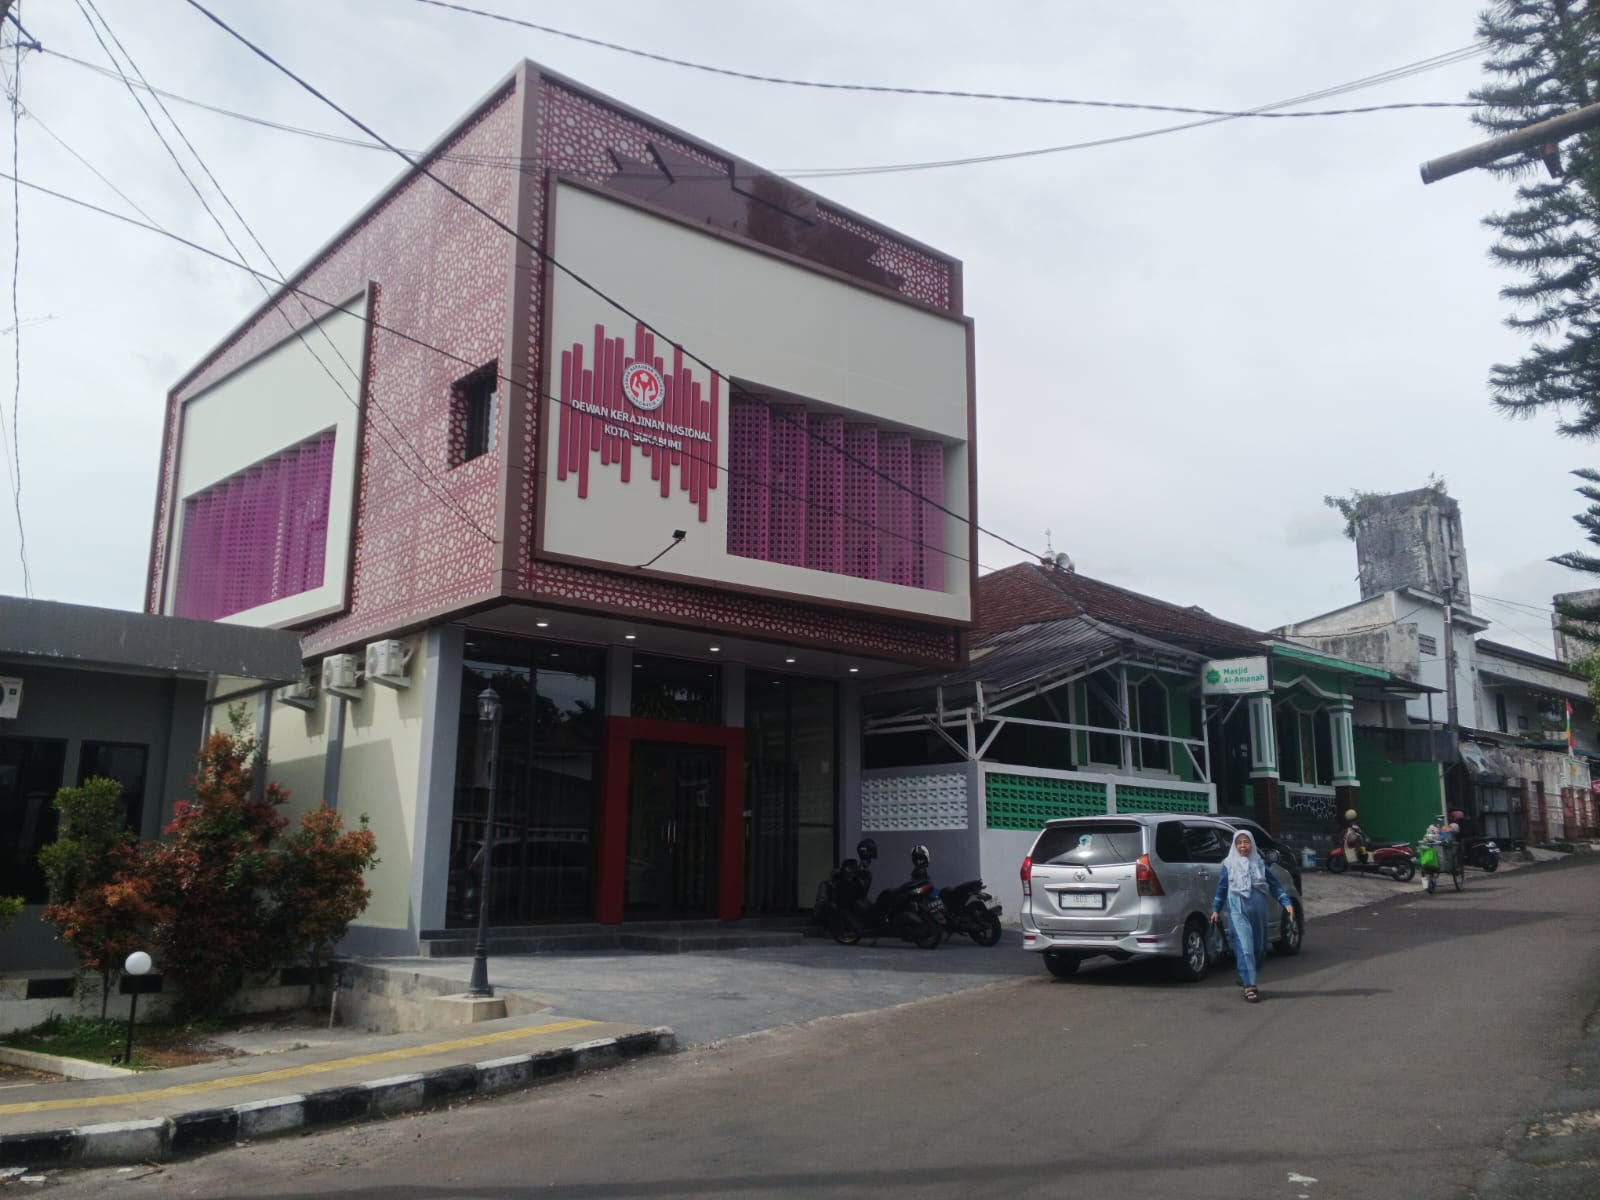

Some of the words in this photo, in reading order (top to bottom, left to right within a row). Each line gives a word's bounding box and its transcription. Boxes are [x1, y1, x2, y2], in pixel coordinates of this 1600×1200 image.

[572, 399, 609, 416] DEWAN
[610, 409, 665, 431] KERAJINAN
[666, 423, 712, 442] NASIONAL
[604, 424, 630, 440] KOTA
[1223, 666, 1248, 676] Masjid
[1223, 674, 1264, 684] Al-Amanah
